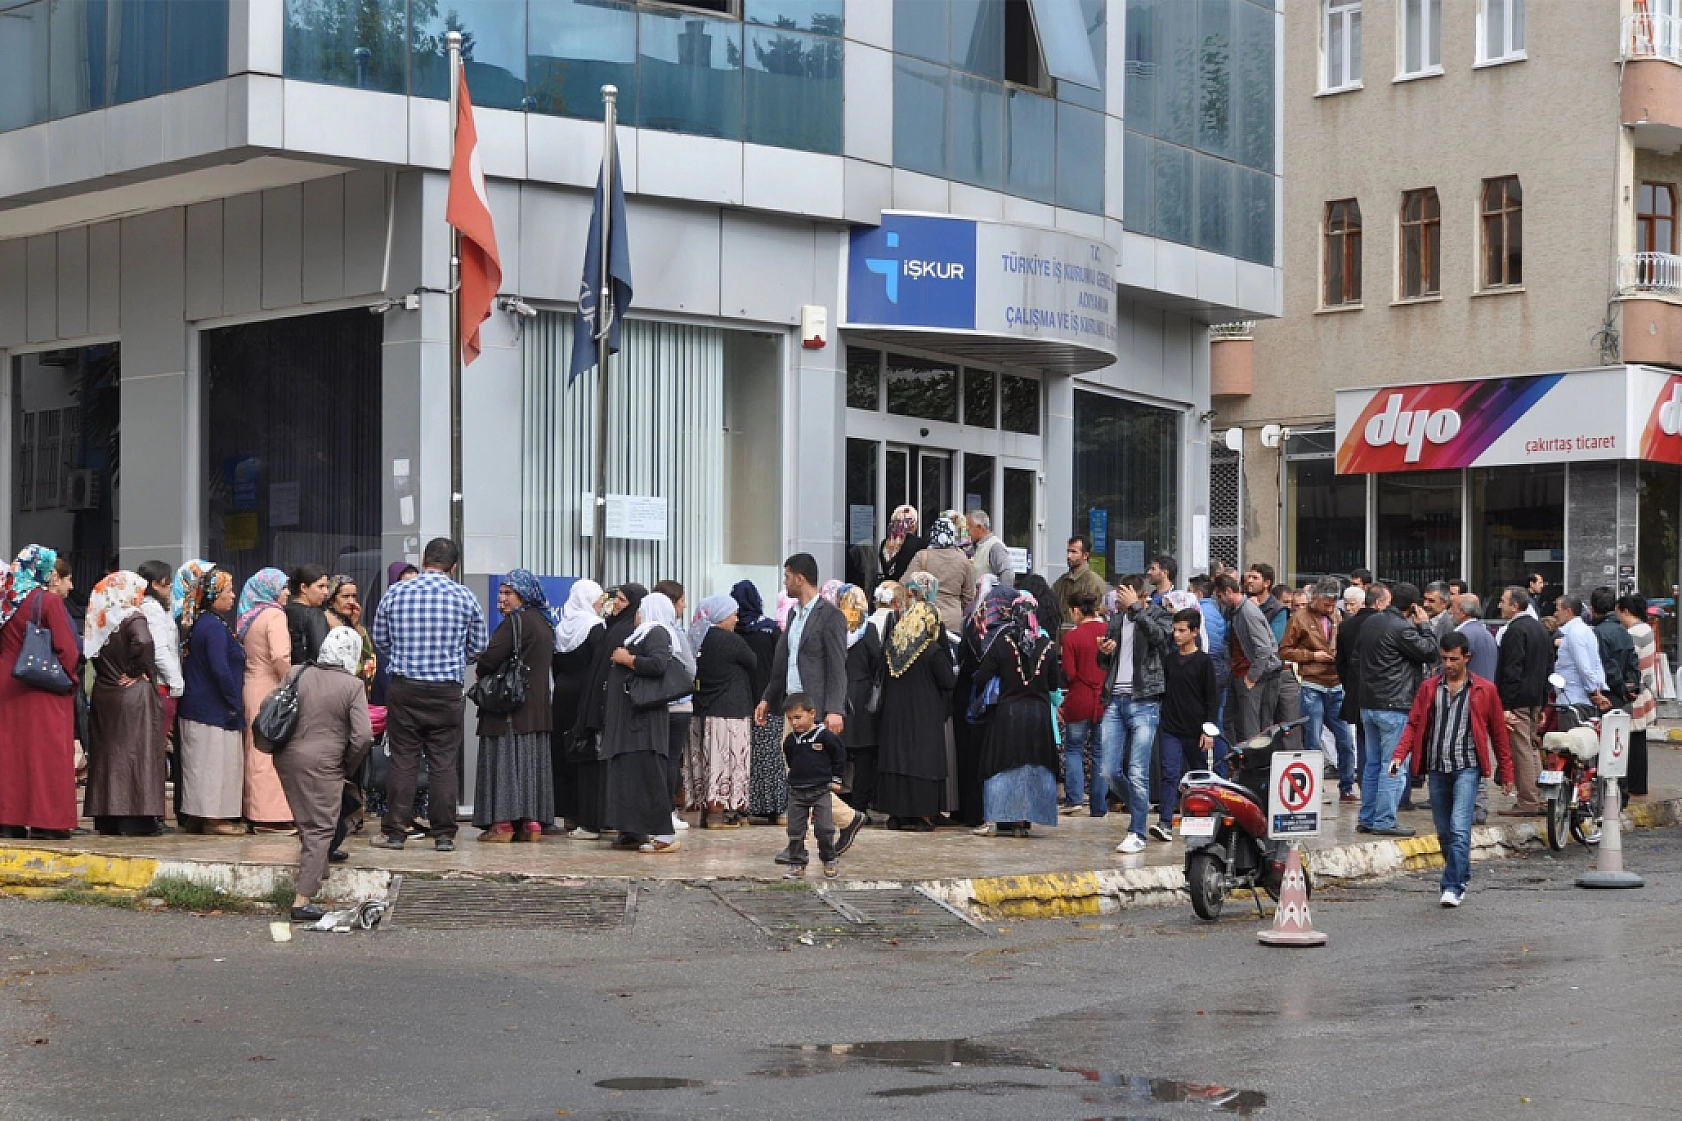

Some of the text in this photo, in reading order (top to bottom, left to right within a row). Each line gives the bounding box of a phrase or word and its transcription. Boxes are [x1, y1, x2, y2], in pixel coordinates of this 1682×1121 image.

[1001, 251, 1050, 277] TÜRKİYE
[1052, 256, 1062, 283] İŞ
[1005, 305, 1056, 332] ÇALIŞMA
[1057, 311, 1069, 330] VE
[1363, 393, 1461, 463] dyo
[1525, 434, 1616, 455] çakırtaş ticaret
